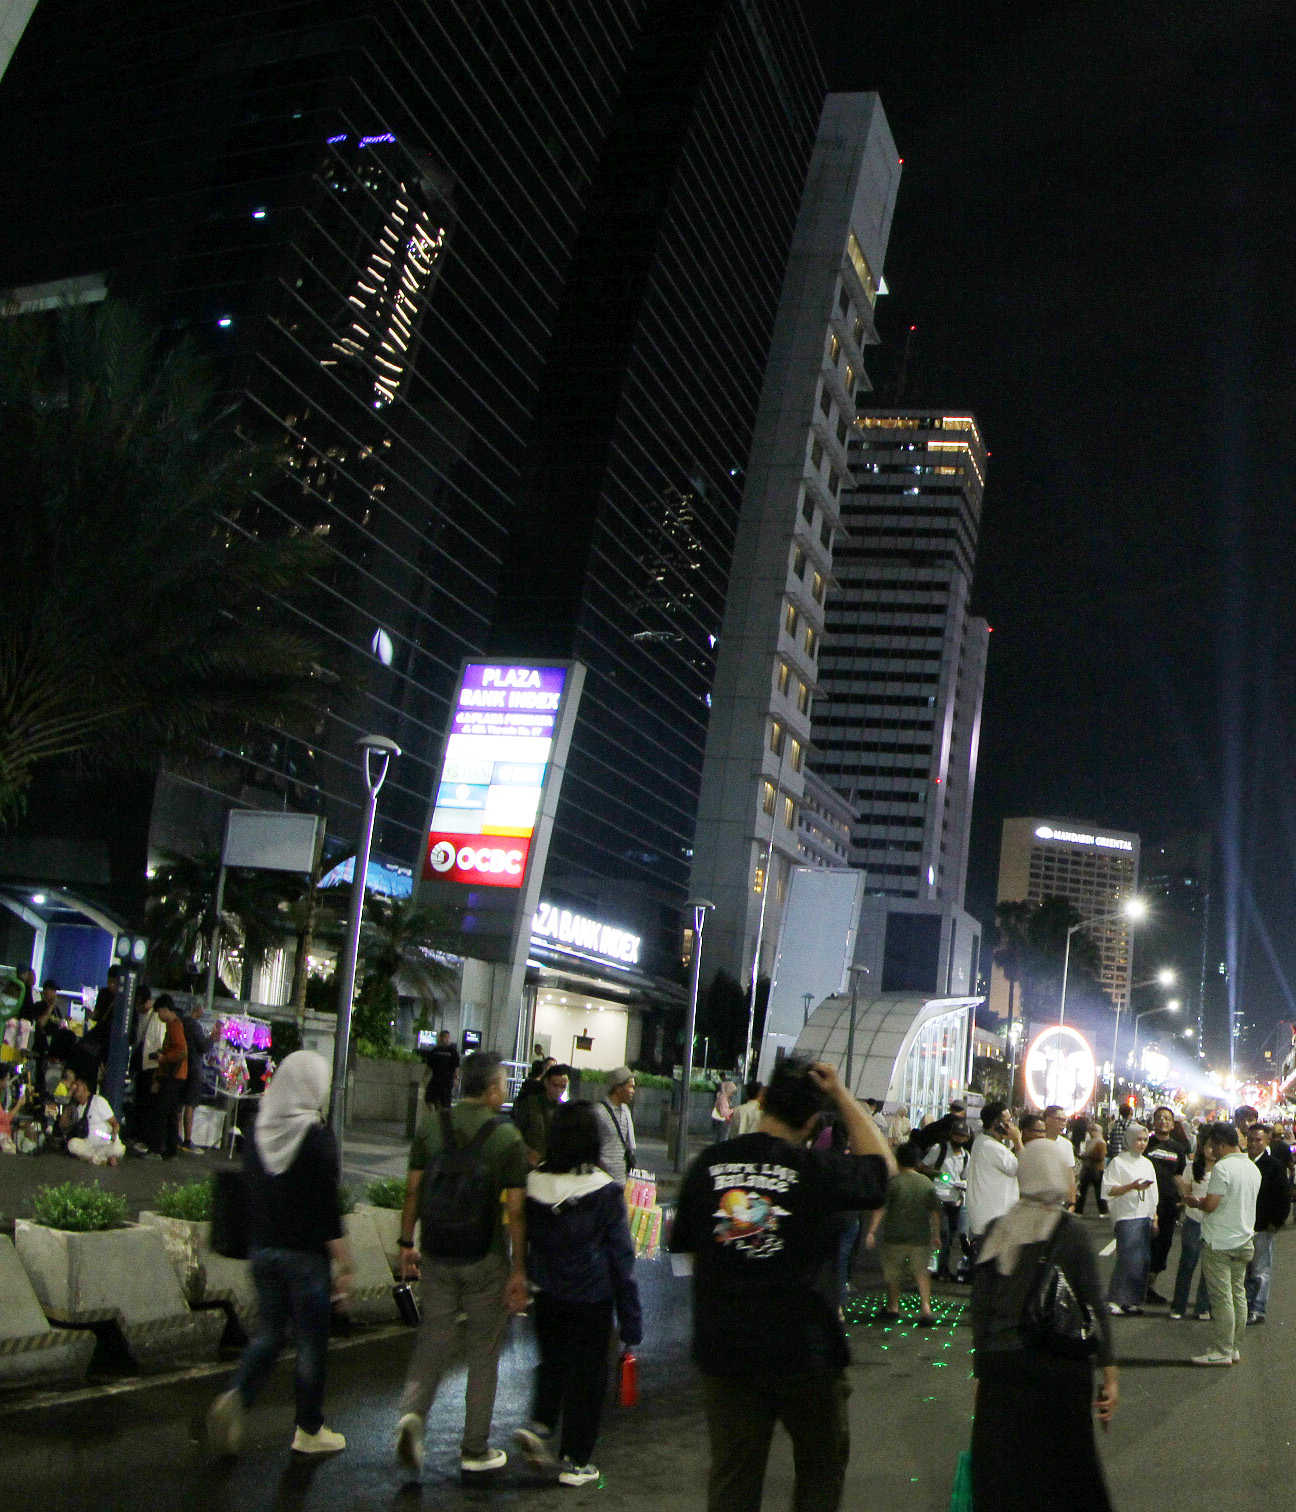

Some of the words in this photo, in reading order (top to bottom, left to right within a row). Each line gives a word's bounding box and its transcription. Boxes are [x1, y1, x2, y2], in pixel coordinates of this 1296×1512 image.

[482, 668, 541, 688] PLAZA
[460, 688, 506, 707] BANK
[508, 691, 560, 709] INDEX
[1053, 829, 1095, 845] MANDARIN
[1095, 836, 1133, 851] ORIENTAL
[456, 846, 522, 875] OCBC
[558, 910, 602, 952] BANK
[599, 925, 641, 964] INDEX
